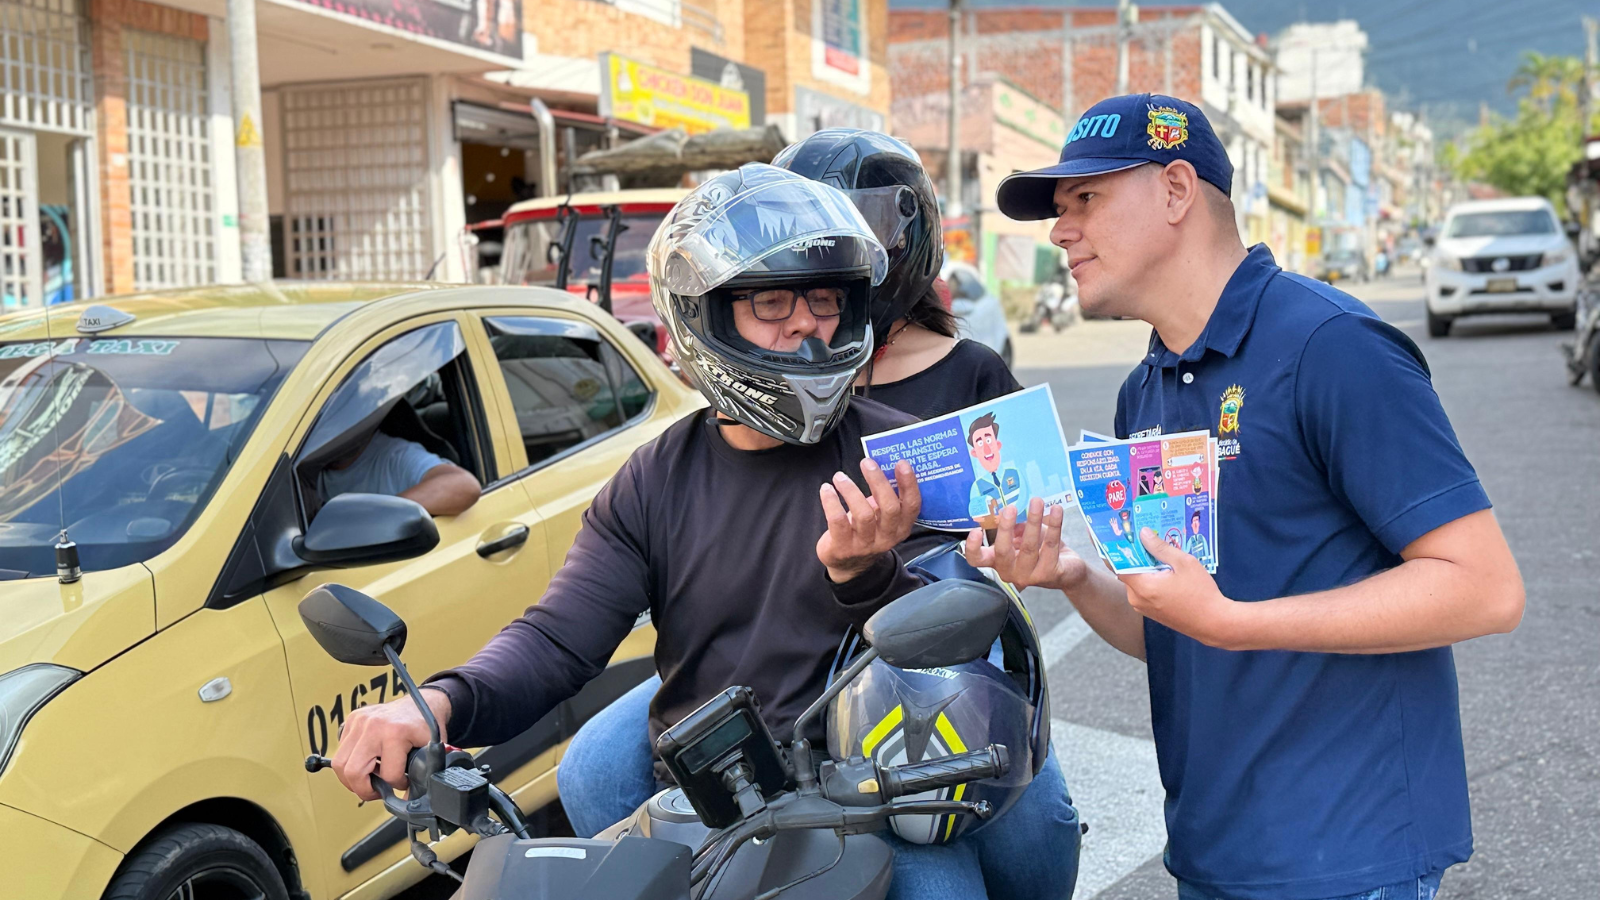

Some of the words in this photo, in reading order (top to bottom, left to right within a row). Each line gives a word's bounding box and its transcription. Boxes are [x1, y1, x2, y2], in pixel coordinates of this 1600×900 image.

[84, 318, 101, 326] TAXI
[87, 340, 181, 355] TAXI
[697, 355, 779, 405] XTRONG
[871, 442, 906, 458] RESPETA
[907, 438, 923, 448] LAS
[923, 428, 958, 443] NORMAS
[889, 453, 901, 462] DE
[916, 454, 927, 464] TE
[927, 446, 959, 461] ESPERA
[915, 460, 942, 473] CASA.
[1108, 490, 1124, 503] PARE
